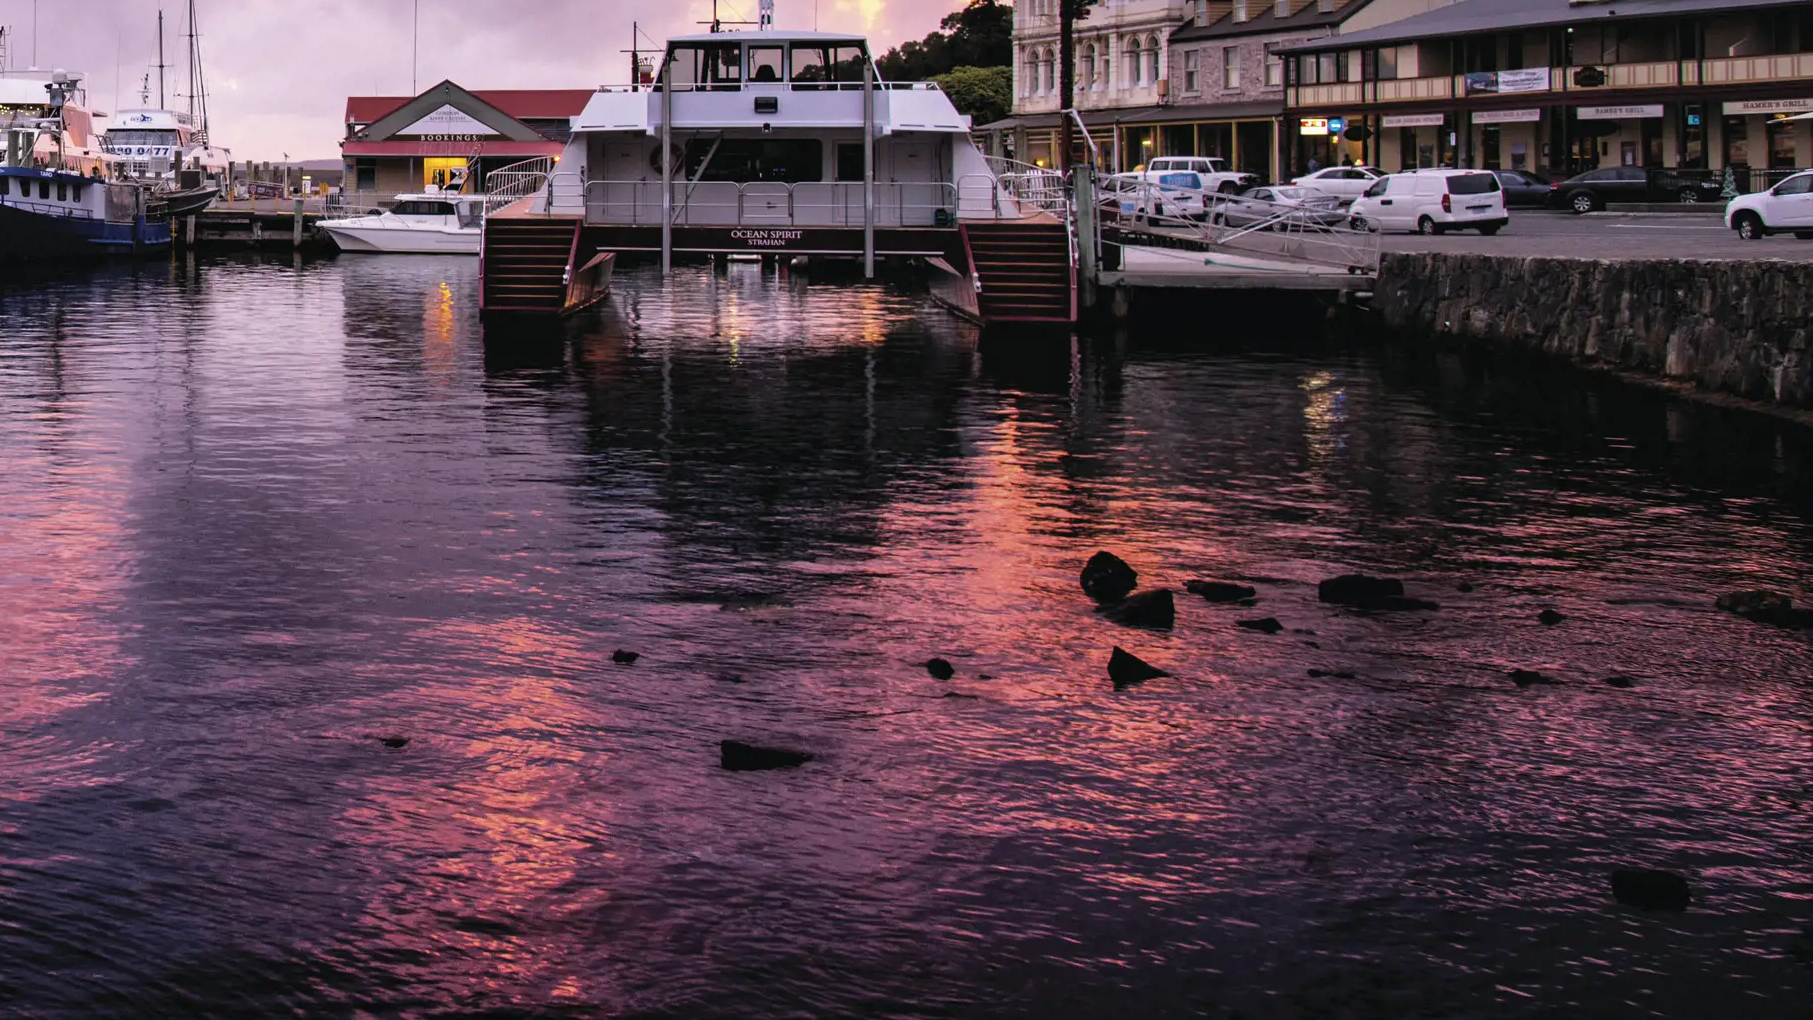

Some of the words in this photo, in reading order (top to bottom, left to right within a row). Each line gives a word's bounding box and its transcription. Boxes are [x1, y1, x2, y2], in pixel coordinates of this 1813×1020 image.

[1742, 101, 1782, 110] HAMER'S
[1782, 100, 1808, 108] GRILL
[730, 229, 768, 239] OCEAN
[770, 230, 803, 240] SPIRIT
